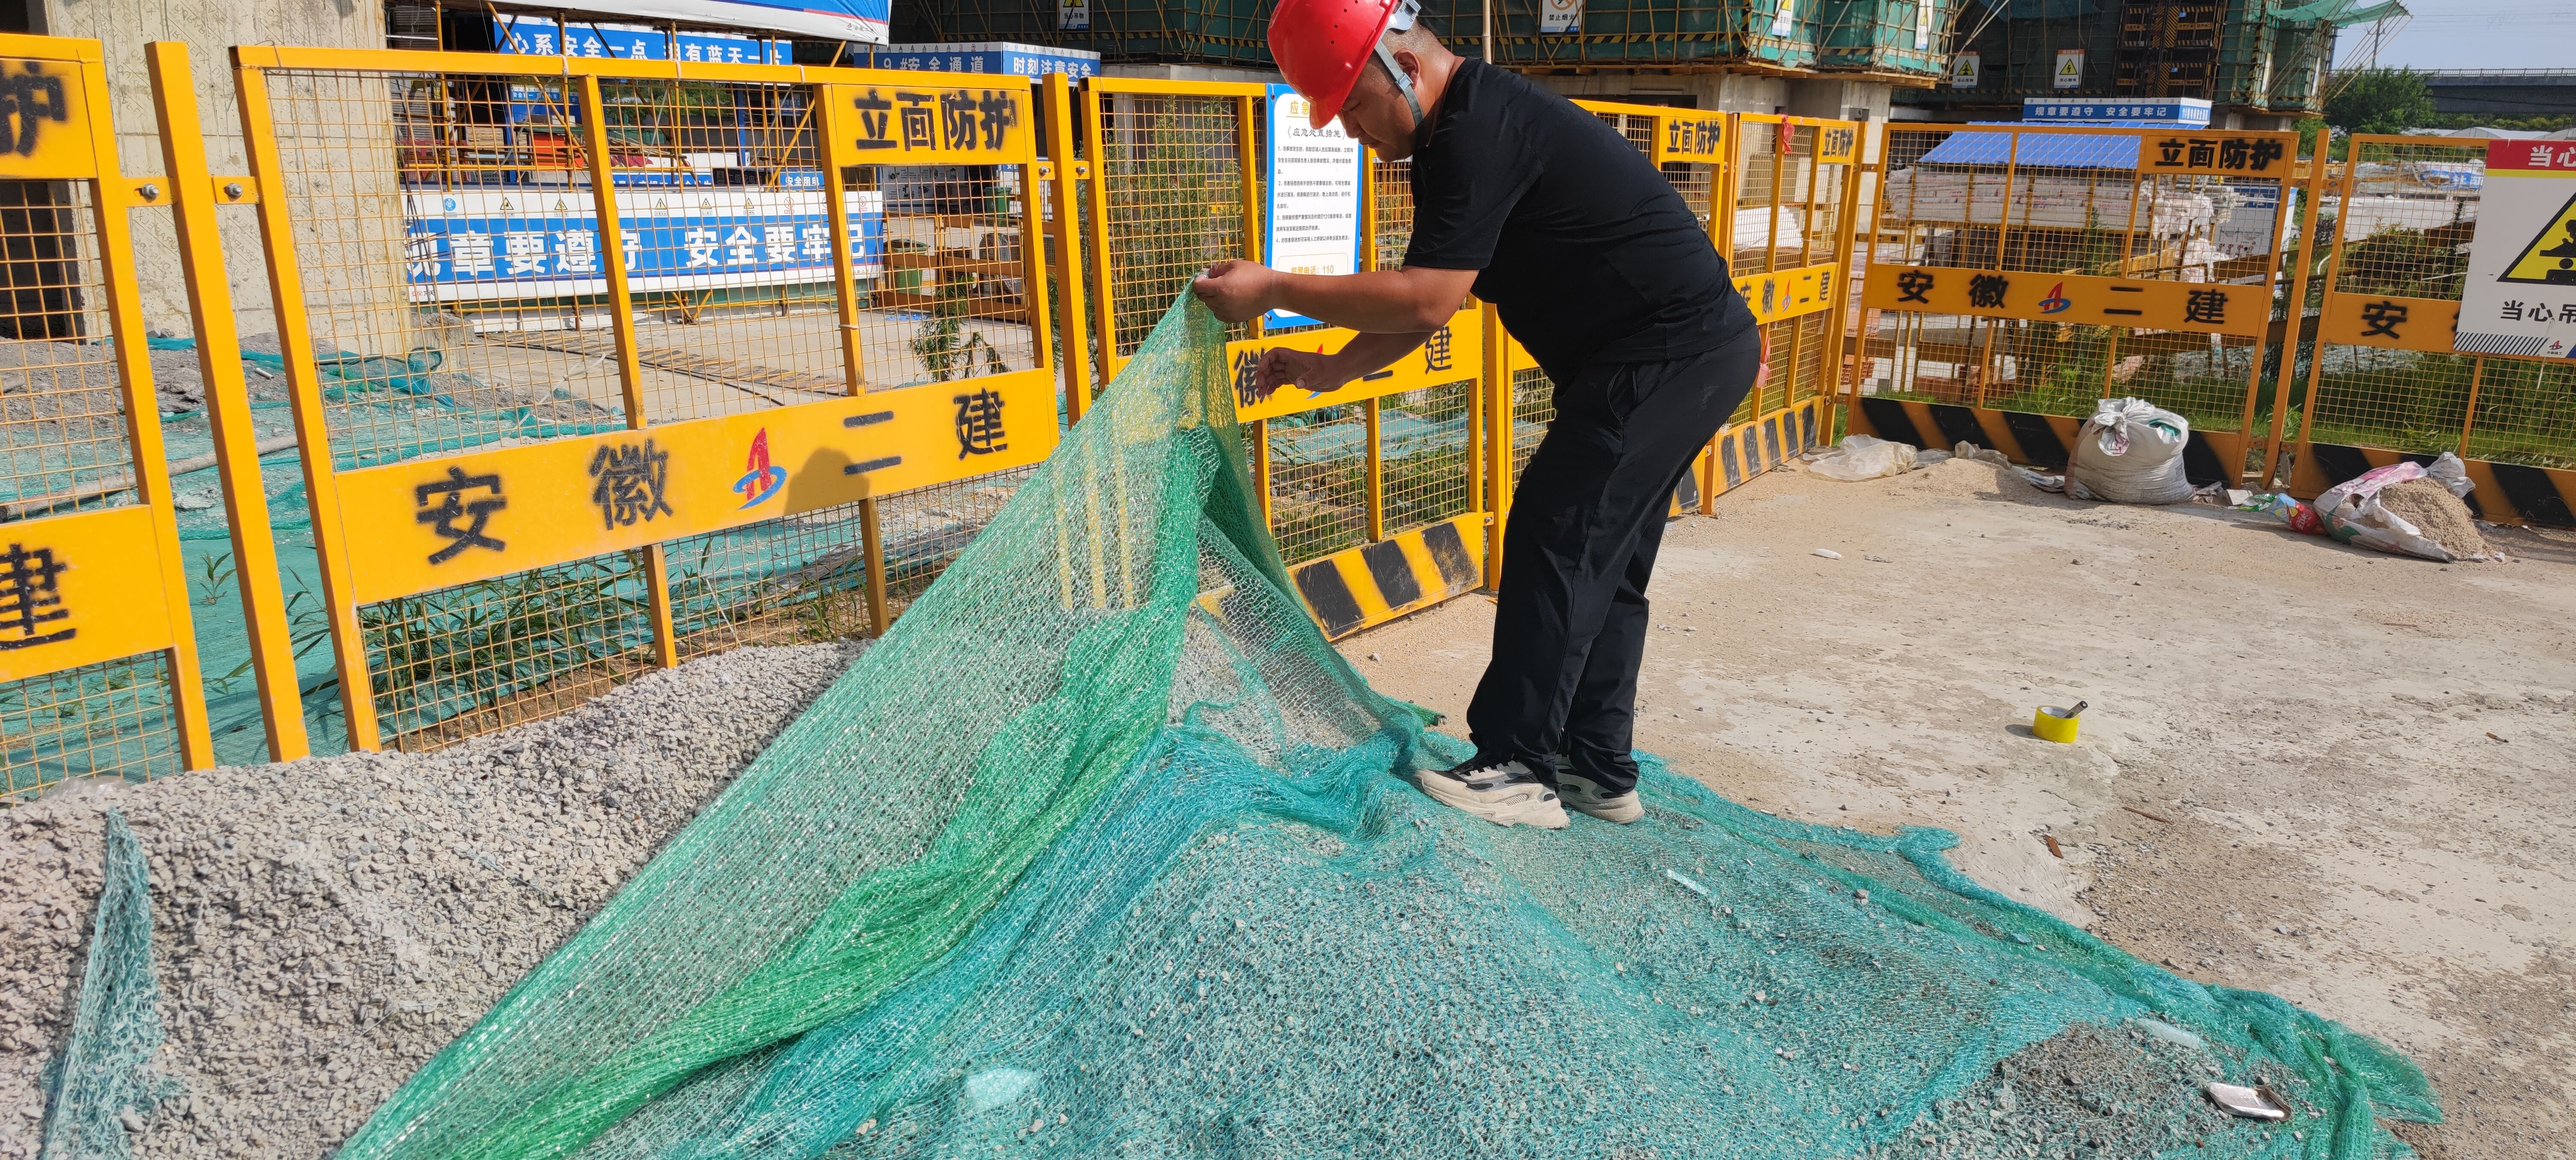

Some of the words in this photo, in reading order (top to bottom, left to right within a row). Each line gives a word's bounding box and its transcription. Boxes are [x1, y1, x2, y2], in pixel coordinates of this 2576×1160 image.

[1014, 56, 1091, 79] 时刻注意安全
[855, 89, 1017, 152] 立面防护
[2035, 107, 2094, 116] 规章要遵守
[2105, 107, 2167, 117] 安全要牢记
[1667, 119, 1720, 155] 立面防护
[1822, 129, 1854, 158] 立面防护
[2156, 139, 2283, 171] 立面防护
[2528, 145, 2576, 167] 当心
[785, 176, 820, 186] 安全用电
[2500, 300, 2576, 324] 当心吊
